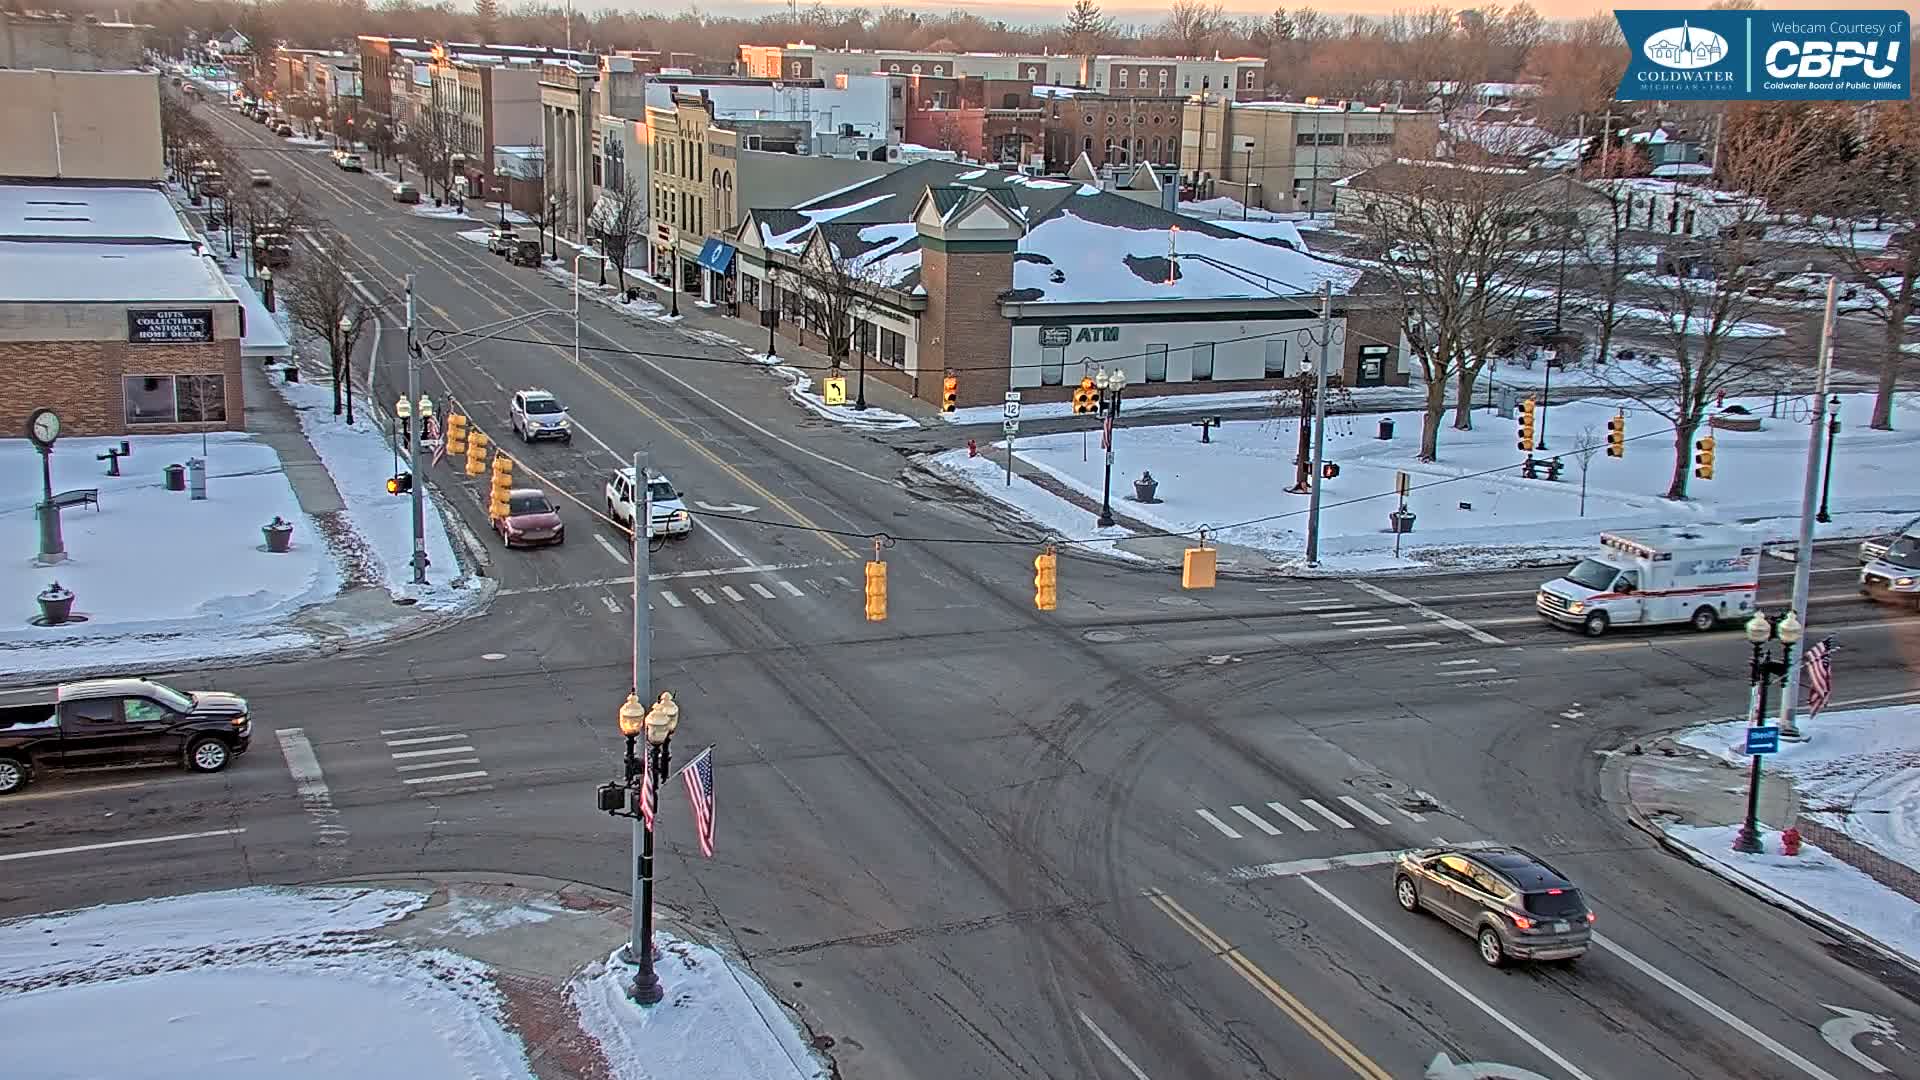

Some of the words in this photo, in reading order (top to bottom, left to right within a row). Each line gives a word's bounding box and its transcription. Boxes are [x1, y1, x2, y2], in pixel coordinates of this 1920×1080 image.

[157, 311, 184, 319] GIFTS
[148, 324, 195, 332] ANTIQUES
[1075, 327, 1120, 343] ATM
[1007, 404, 1017, 414] 12
